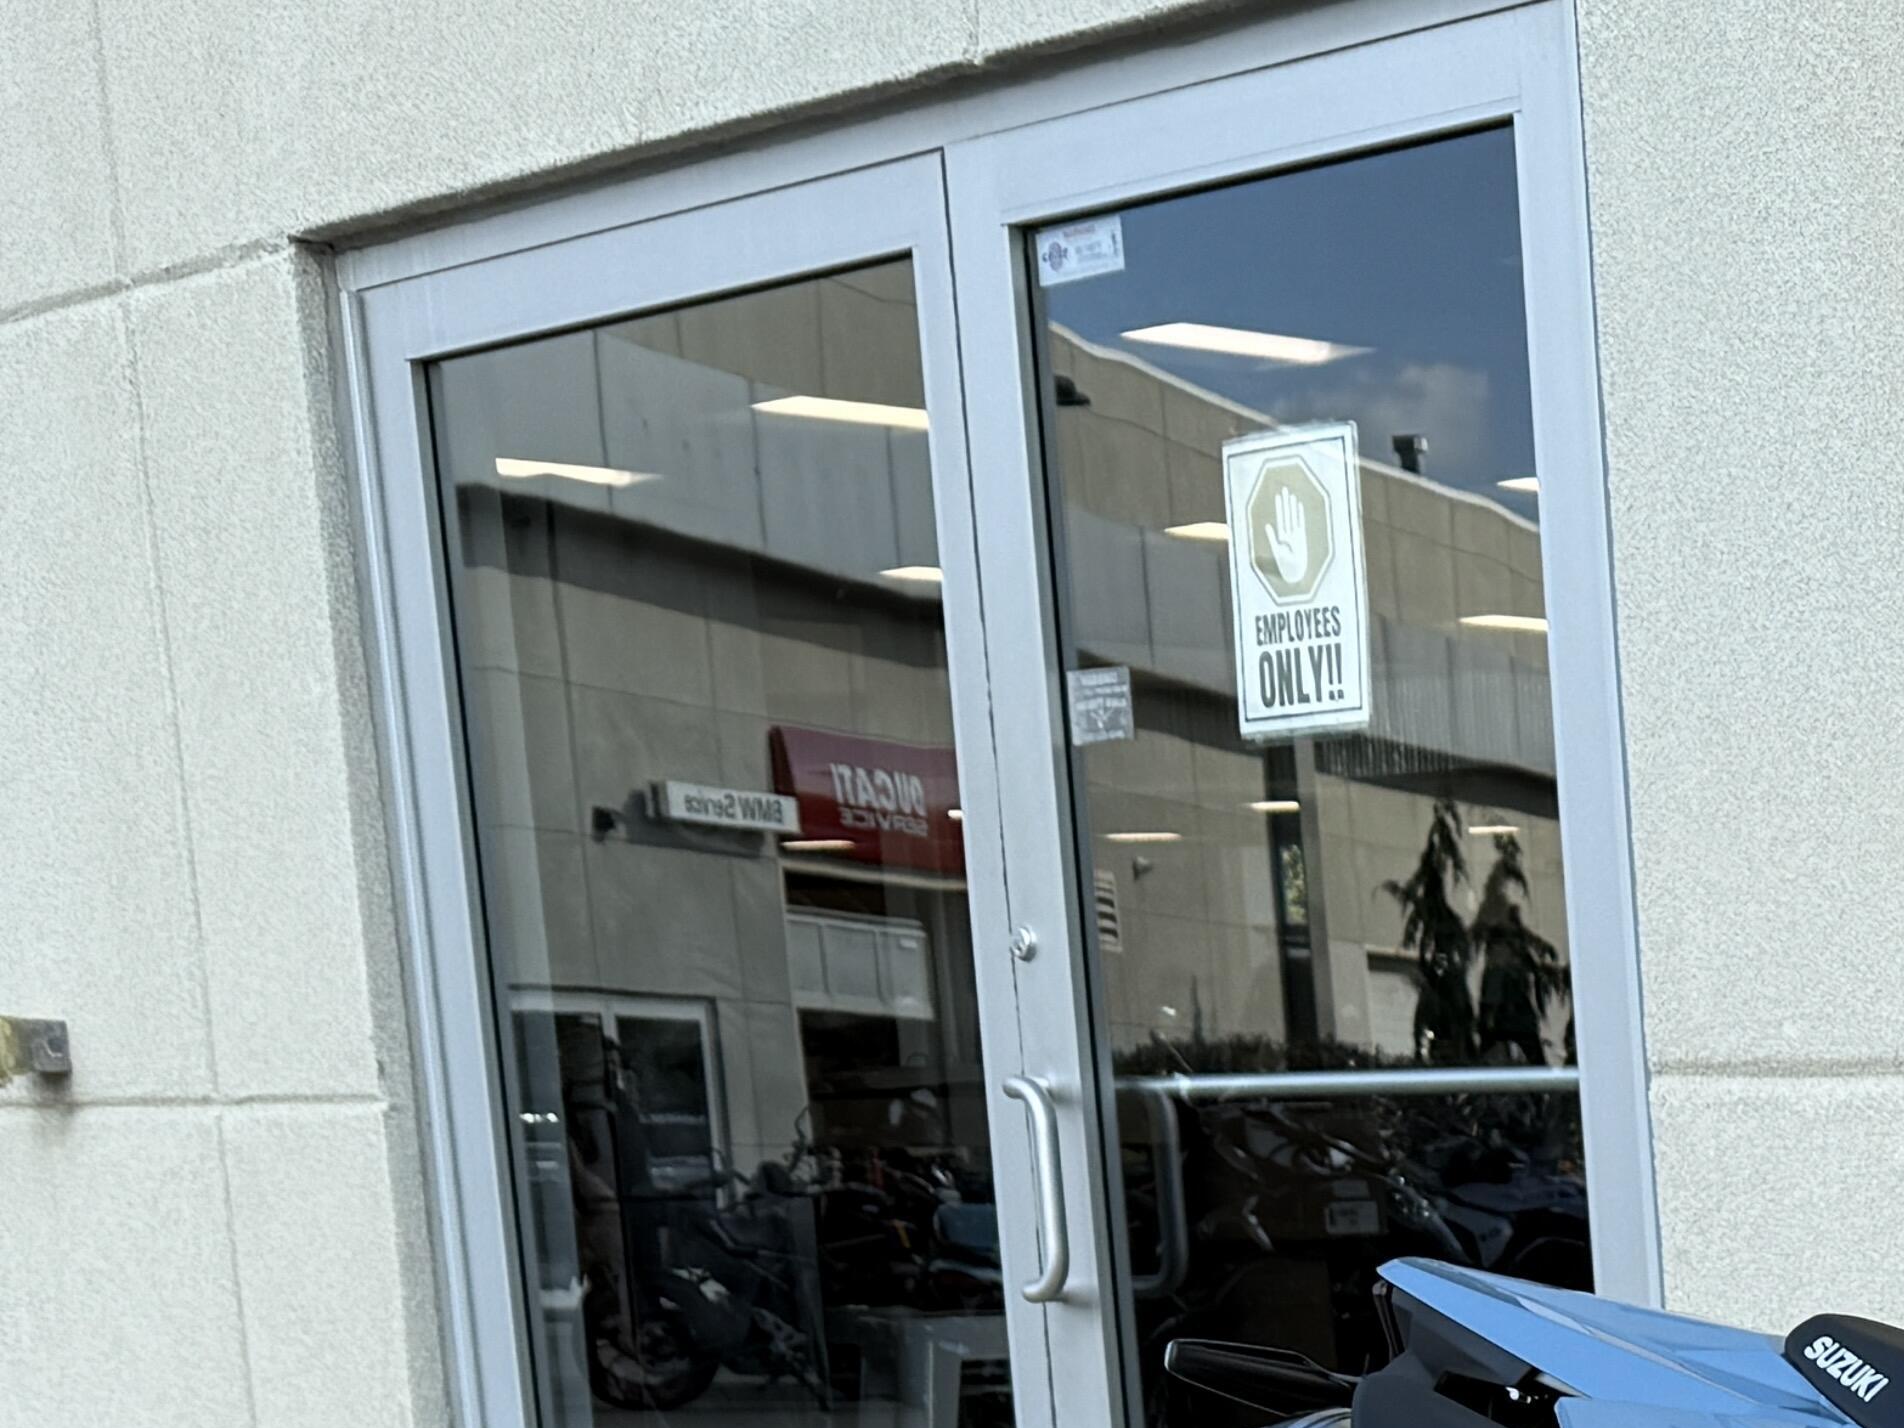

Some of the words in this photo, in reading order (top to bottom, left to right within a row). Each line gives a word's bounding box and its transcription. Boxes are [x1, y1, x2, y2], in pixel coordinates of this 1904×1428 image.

[1254, 606, 1342, 647] EMPLOYEES
[1258, 643, 1345, 710] ONLY!!
[1804, 1335, 1889, 1403] SUZUKI
